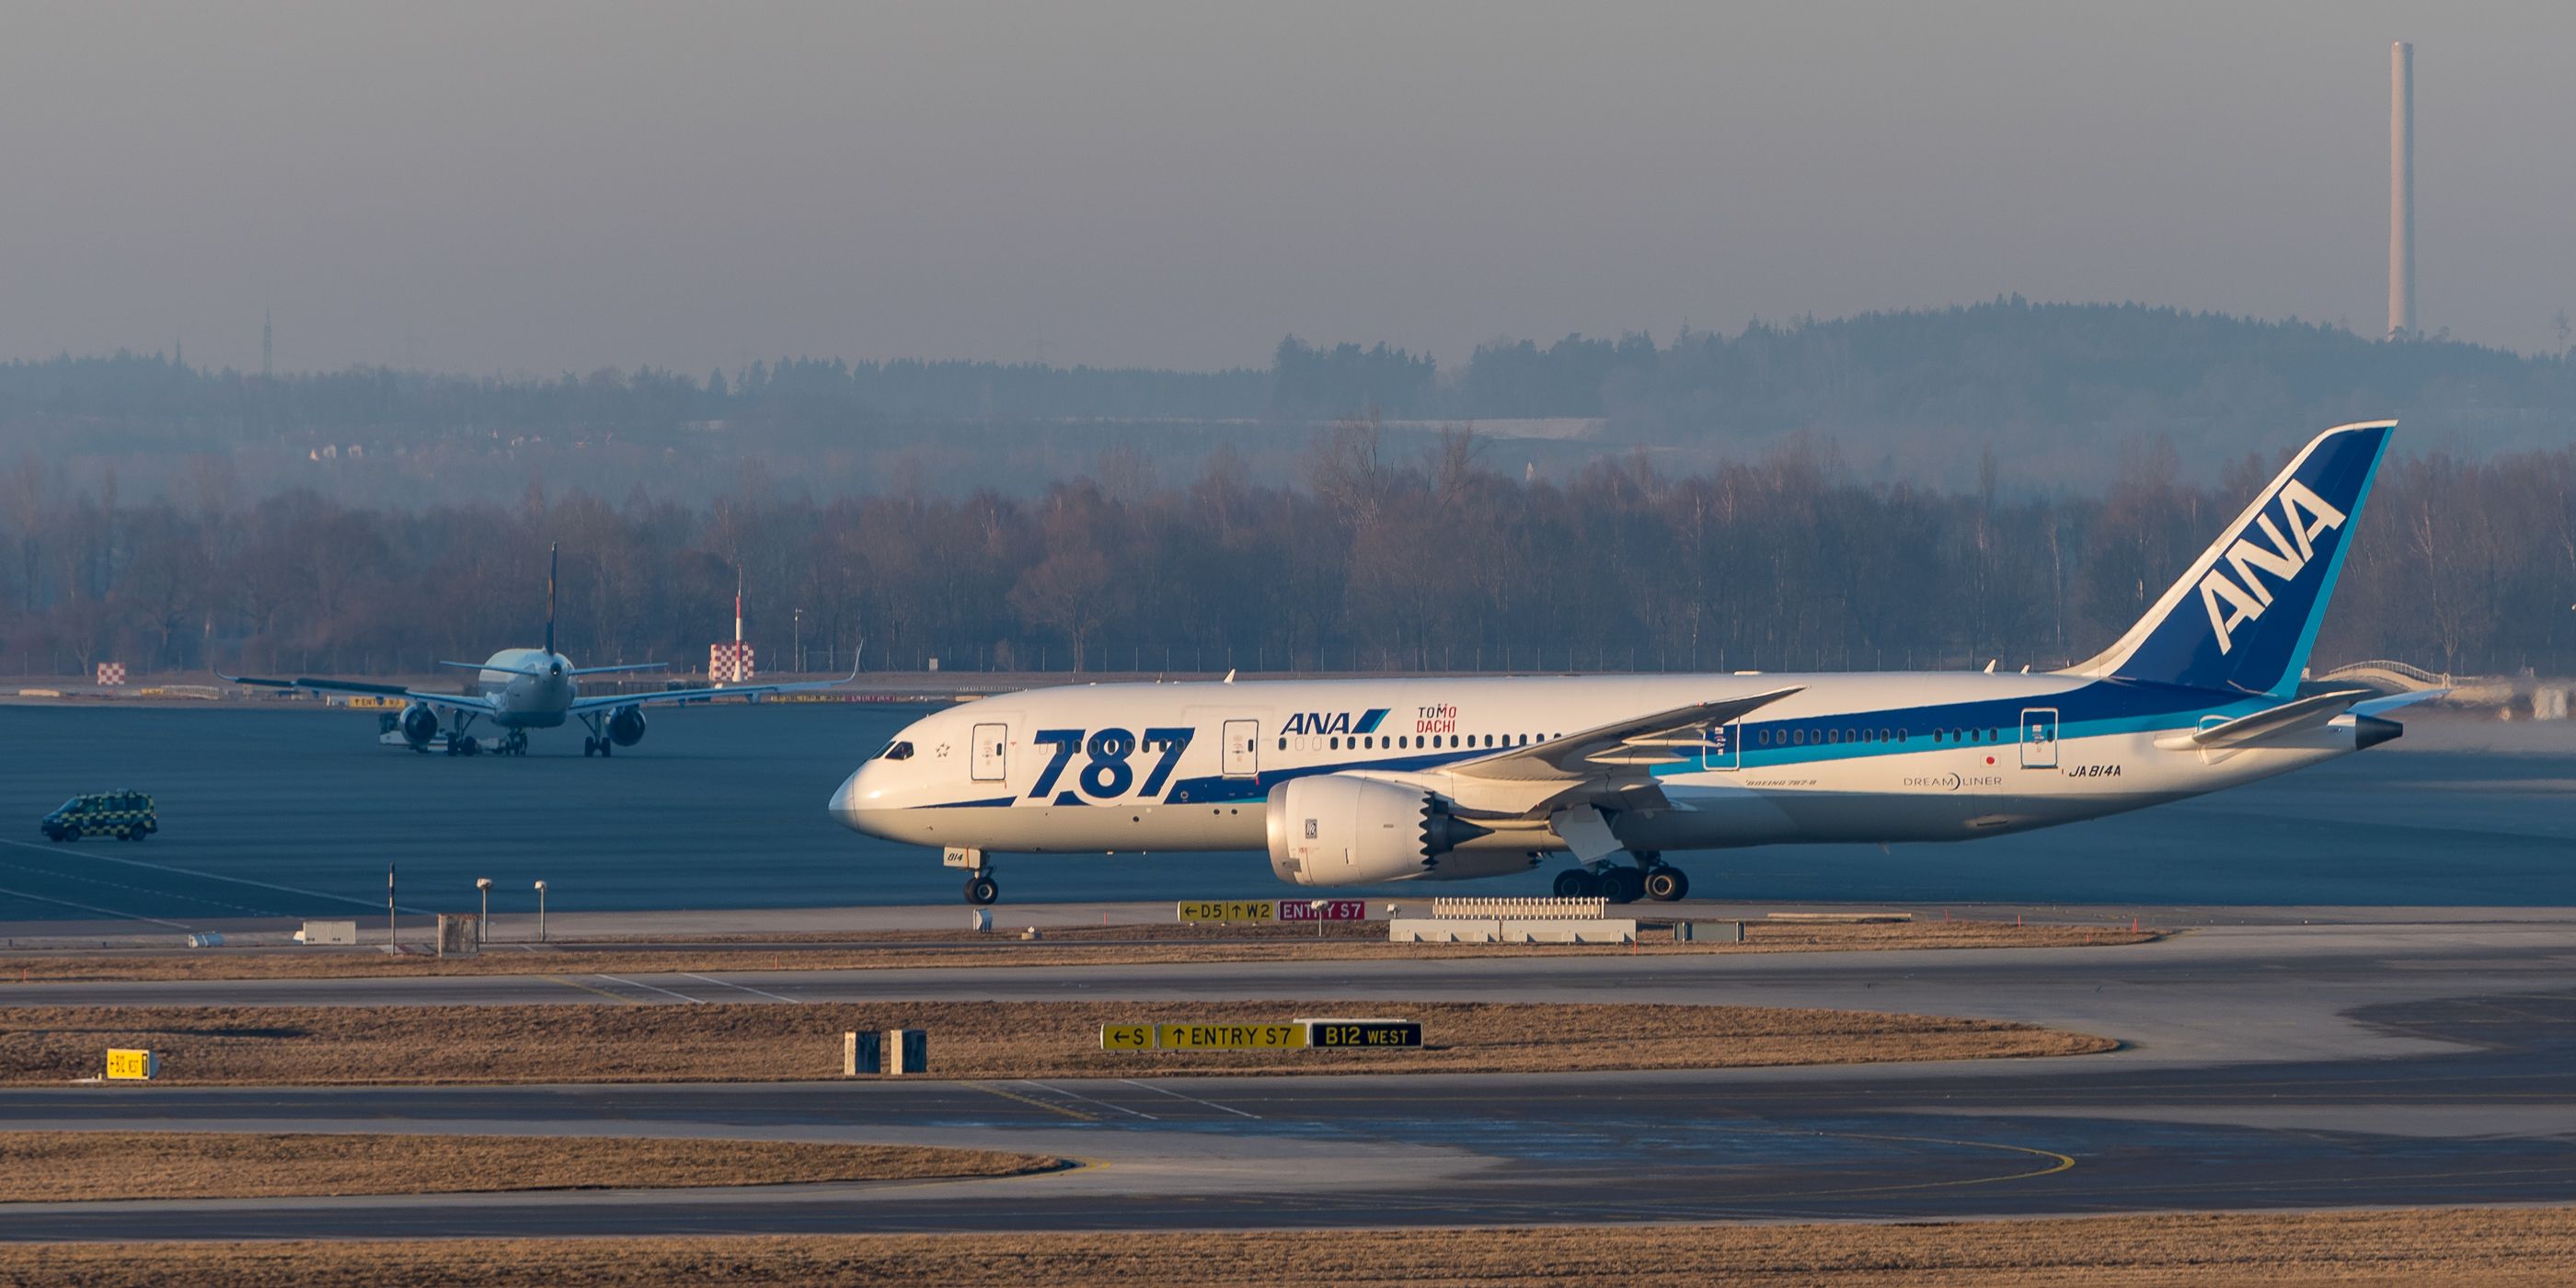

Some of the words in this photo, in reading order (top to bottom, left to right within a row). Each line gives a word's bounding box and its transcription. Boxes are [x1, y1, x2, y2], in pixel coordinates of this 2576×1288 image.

[2199, 478, 2346, 656] ANA
[1418, 704, 1457, 719] TOMO
[1280, 712, 1350, 735] ANA
[1416, 720, 1455, 733] DACHI
[1028, 728, 1195, 799] 787
[2068, 765, 2122, 777] JA814A
[948, 853, 963, 861] 814
[1202, 905, 1222, 918] D5
[1247, 904, 1270, 918] W2
[1283, 904, 1334, 918] ENTY
[1340, 904, 1361, 918] S7
[1133, 1028, 1144, 1045] S
[1191, 1028, 1258, 1045] ENTRY
[1265, 1028, 1292, 1045] S7
[1326, 1027, 1361, 1045] B12
[1367, 1029, 1409, 1044] WEST
